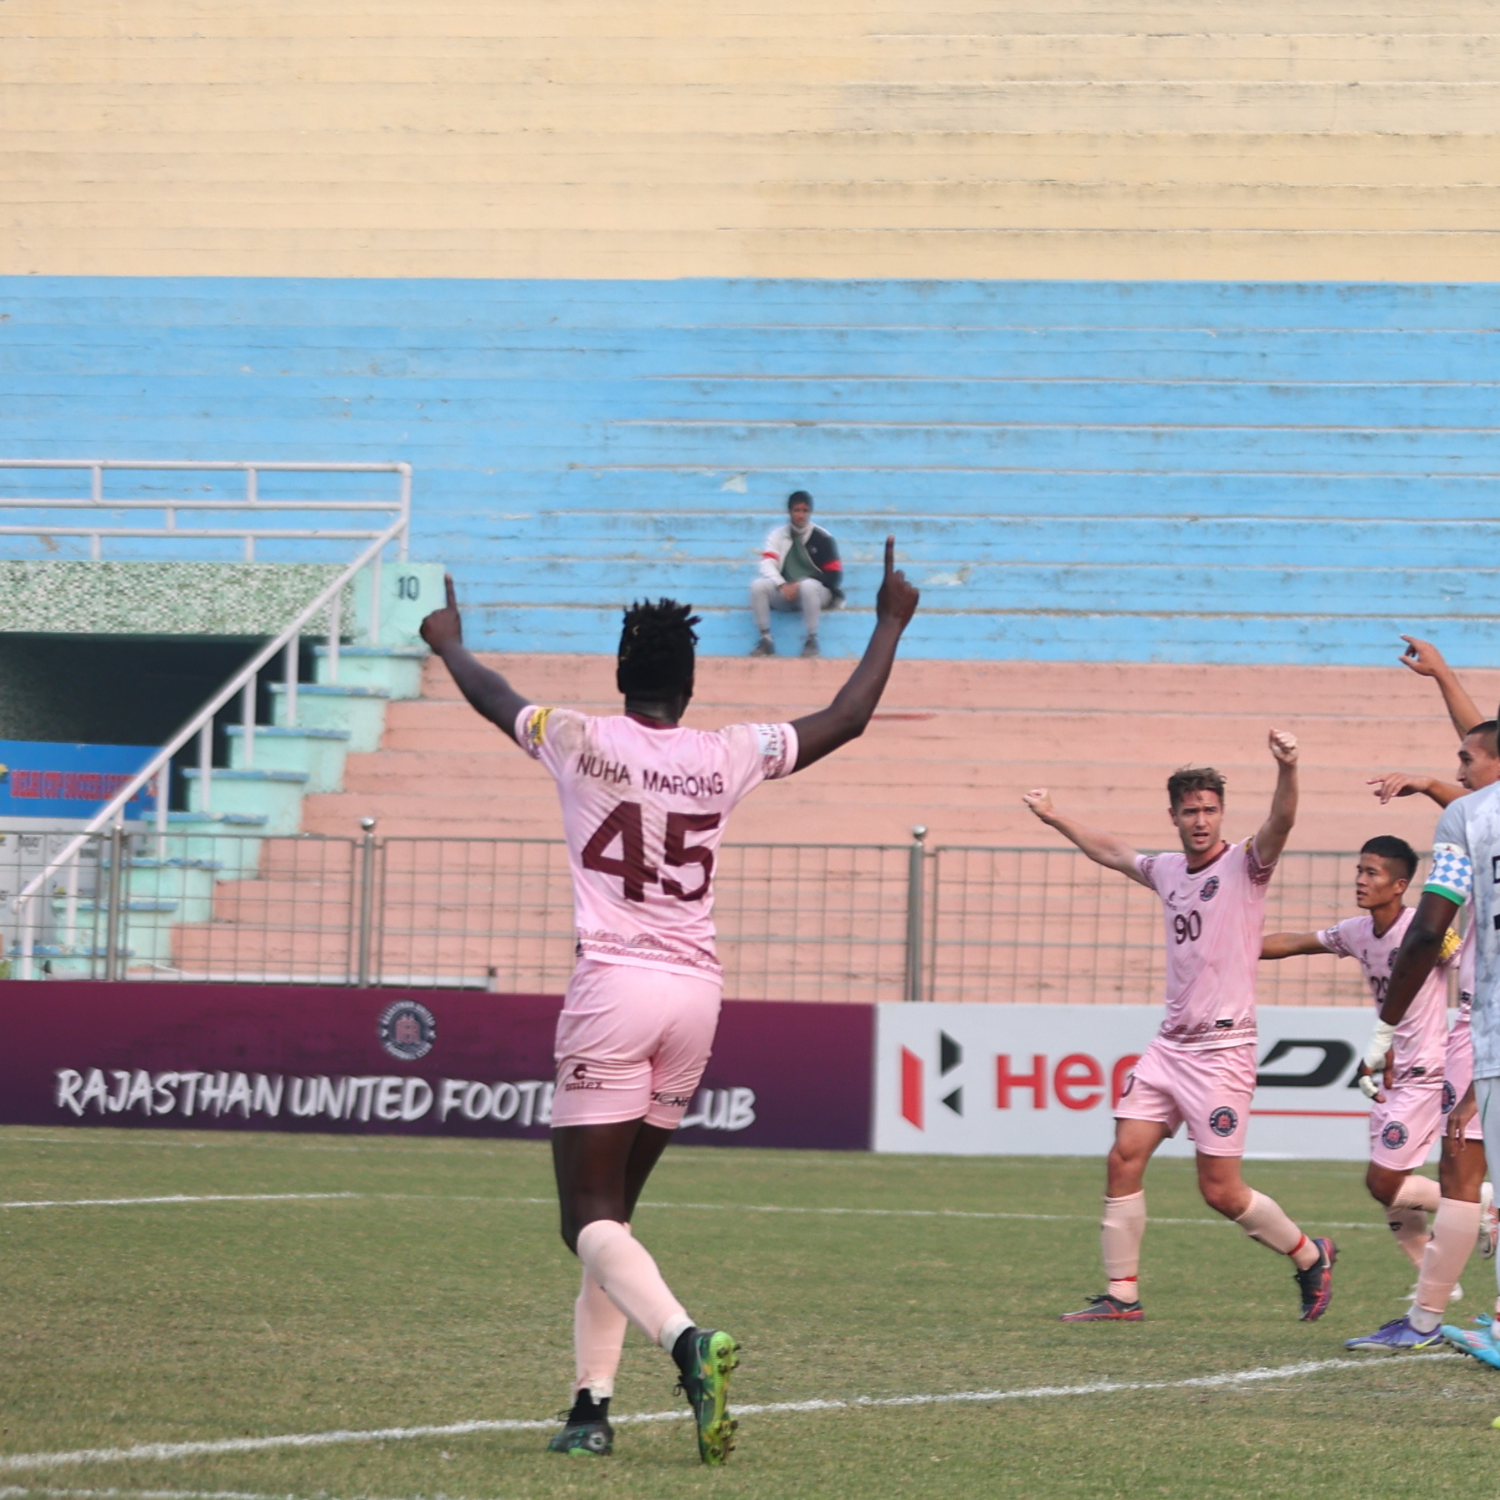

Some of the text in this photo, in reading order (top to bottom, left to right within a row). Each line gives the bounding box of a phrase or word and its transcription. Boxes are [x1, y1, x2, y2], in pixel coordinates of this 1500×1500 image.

[398, 576, 420, 600] 10
[577, 753, 723, 797] NUHA MARONG
[581, 801, 722, 903] 45
[1174, 909, 1202, 945] 90
[56, 1066, 282, 1118] RAJASTHAN
[288, 1074, 434, 1123] UNITED
[439, 1077, 555, 1127] FOOT
[995, 1053, 1142, 1111] Her
